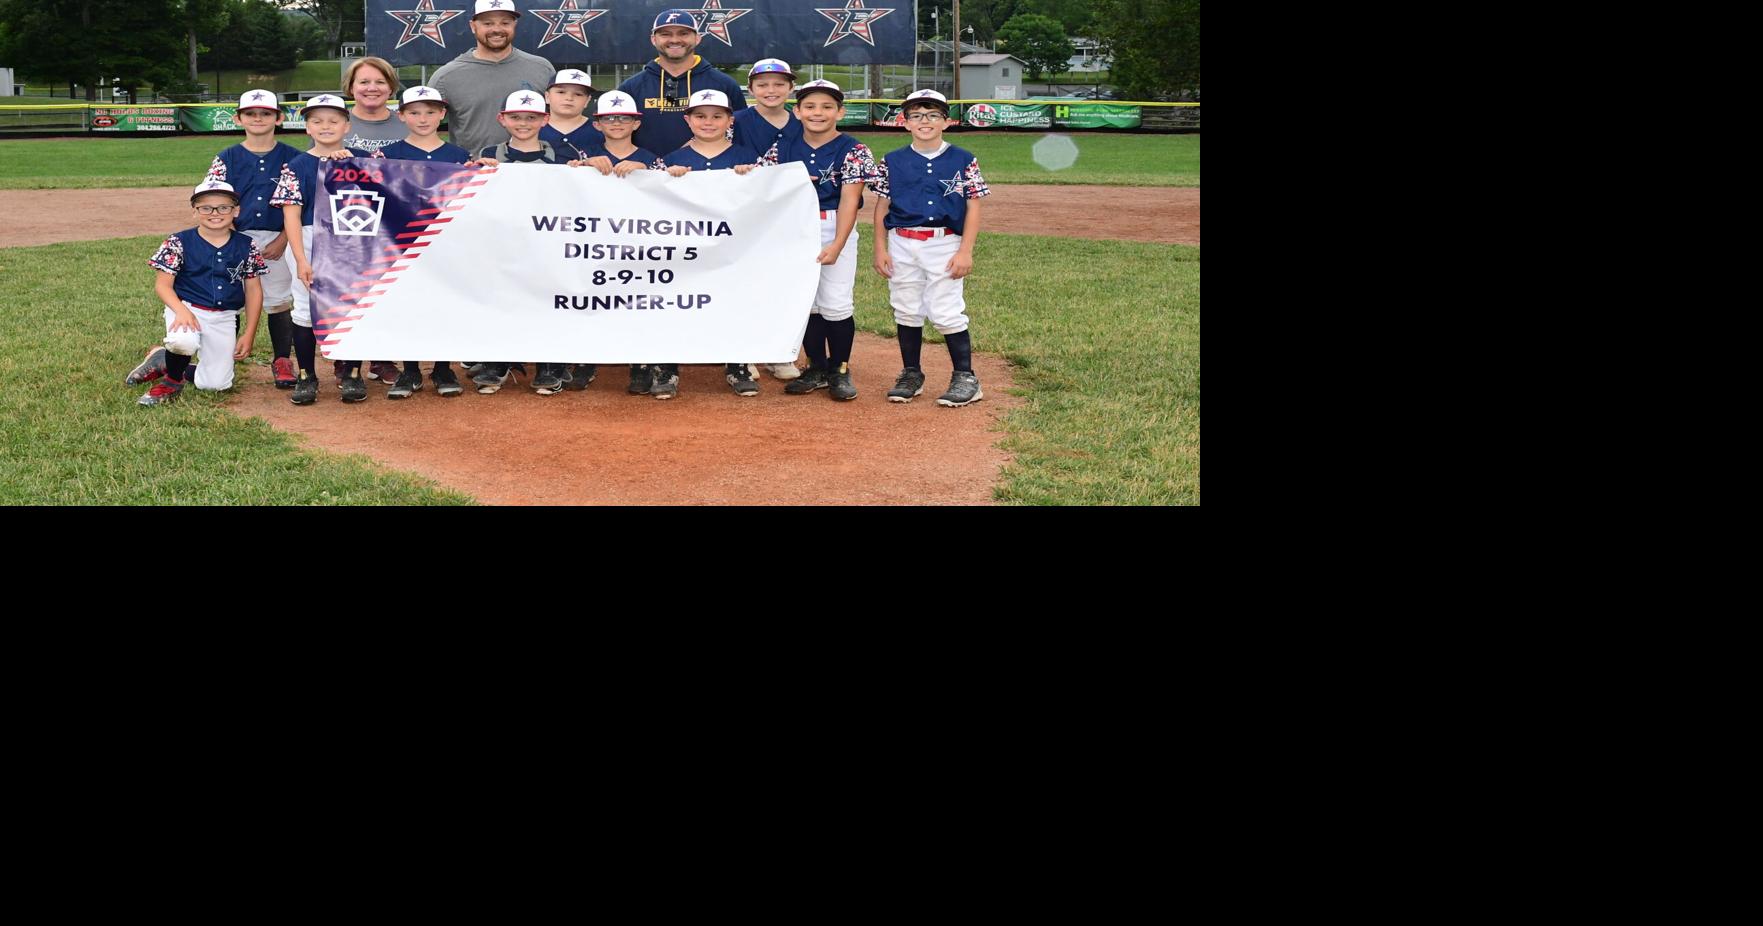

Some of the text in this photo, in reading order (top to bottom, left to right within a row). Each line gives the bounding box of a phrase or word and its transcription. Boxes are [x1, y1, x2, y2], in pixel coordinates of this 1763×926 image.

[969, 110, 997, 121] Rita's
[531, 215, 733, 237] WEST VIRGINIA
[564, 242, 698, 261] DISTRICT 5
[591, 269, 674, 286] 8-9-10
[554, 293, 712, 311] RUNNER-UP
